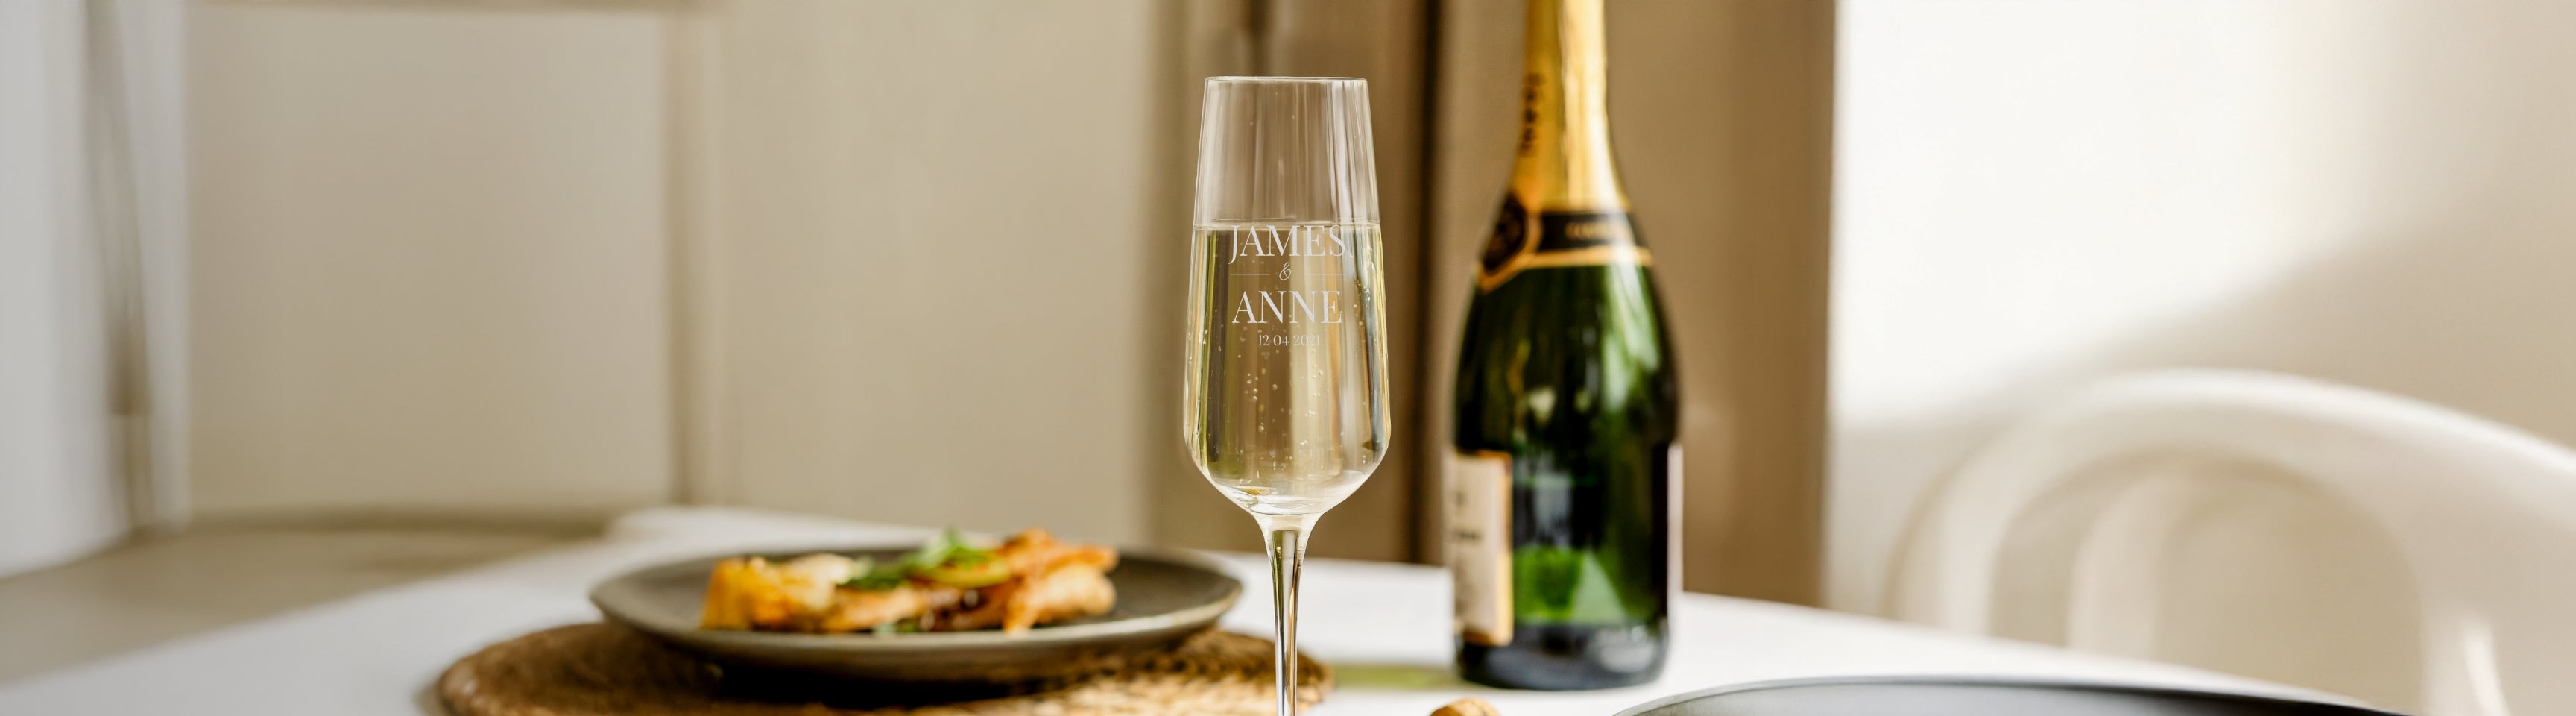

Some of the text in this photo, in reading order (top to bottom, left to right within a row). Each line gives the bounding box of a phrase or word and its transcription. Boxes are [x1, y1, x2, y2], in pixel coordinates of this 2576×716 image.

[1228, 225, 1345, 264] JAMES
[1279, 262, 1292, 280] &
[1231, 290, 1342, 324] ANNE
[1257, 335, 1269, 346] 12
[1273, 335, 1289, 346] 04
